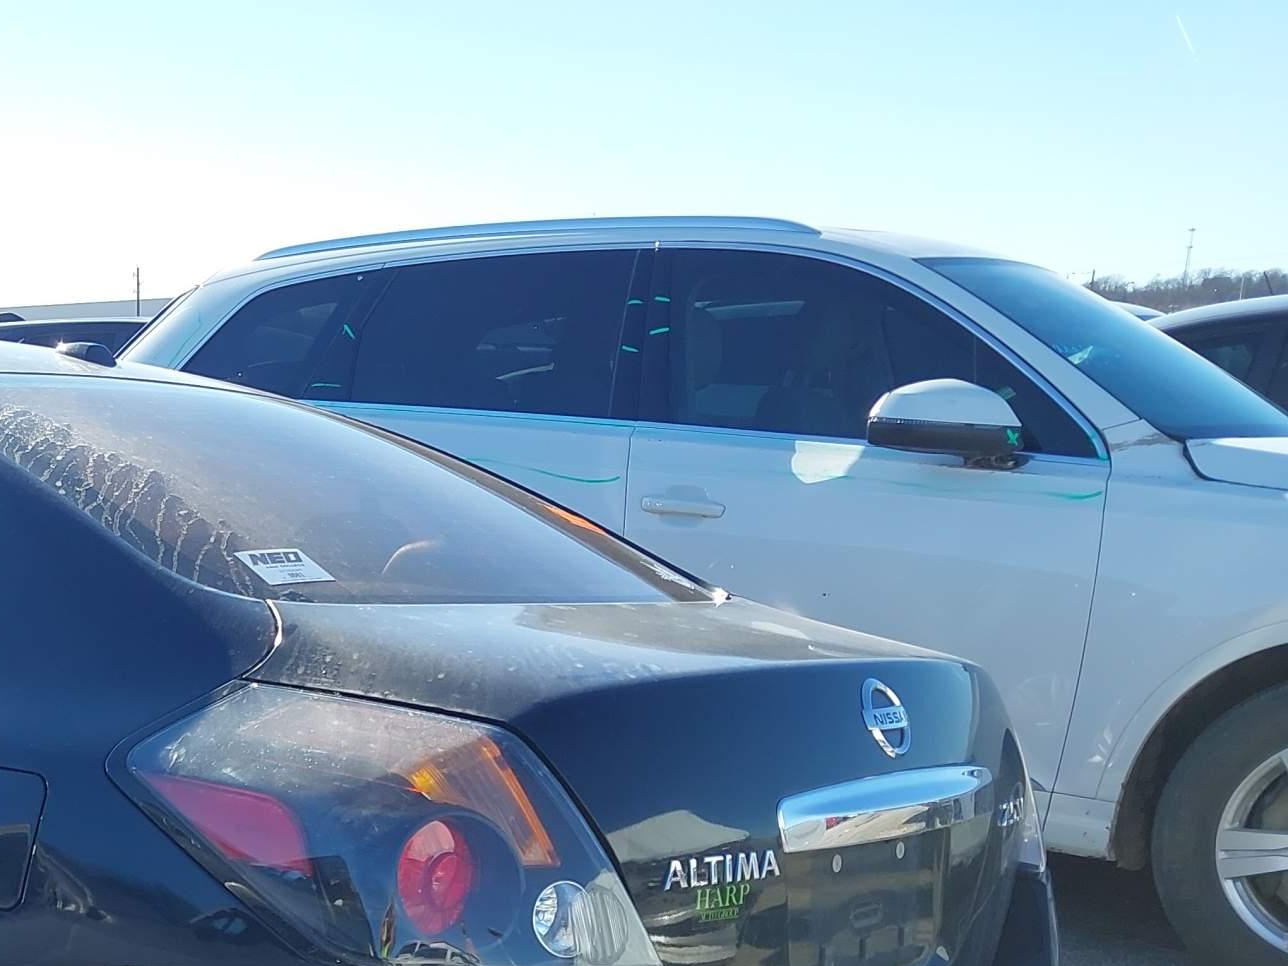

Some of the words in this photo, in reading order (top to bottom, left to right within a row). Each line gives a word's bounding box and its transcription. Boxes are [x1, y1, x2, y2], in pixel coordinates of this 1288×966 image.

[248, 551, 303, 566] NEO
[873, 710, 907, 726] NISSA
[664, 849, 780, 892] ALTIMA
[695, 883, 750, 910] HARP
